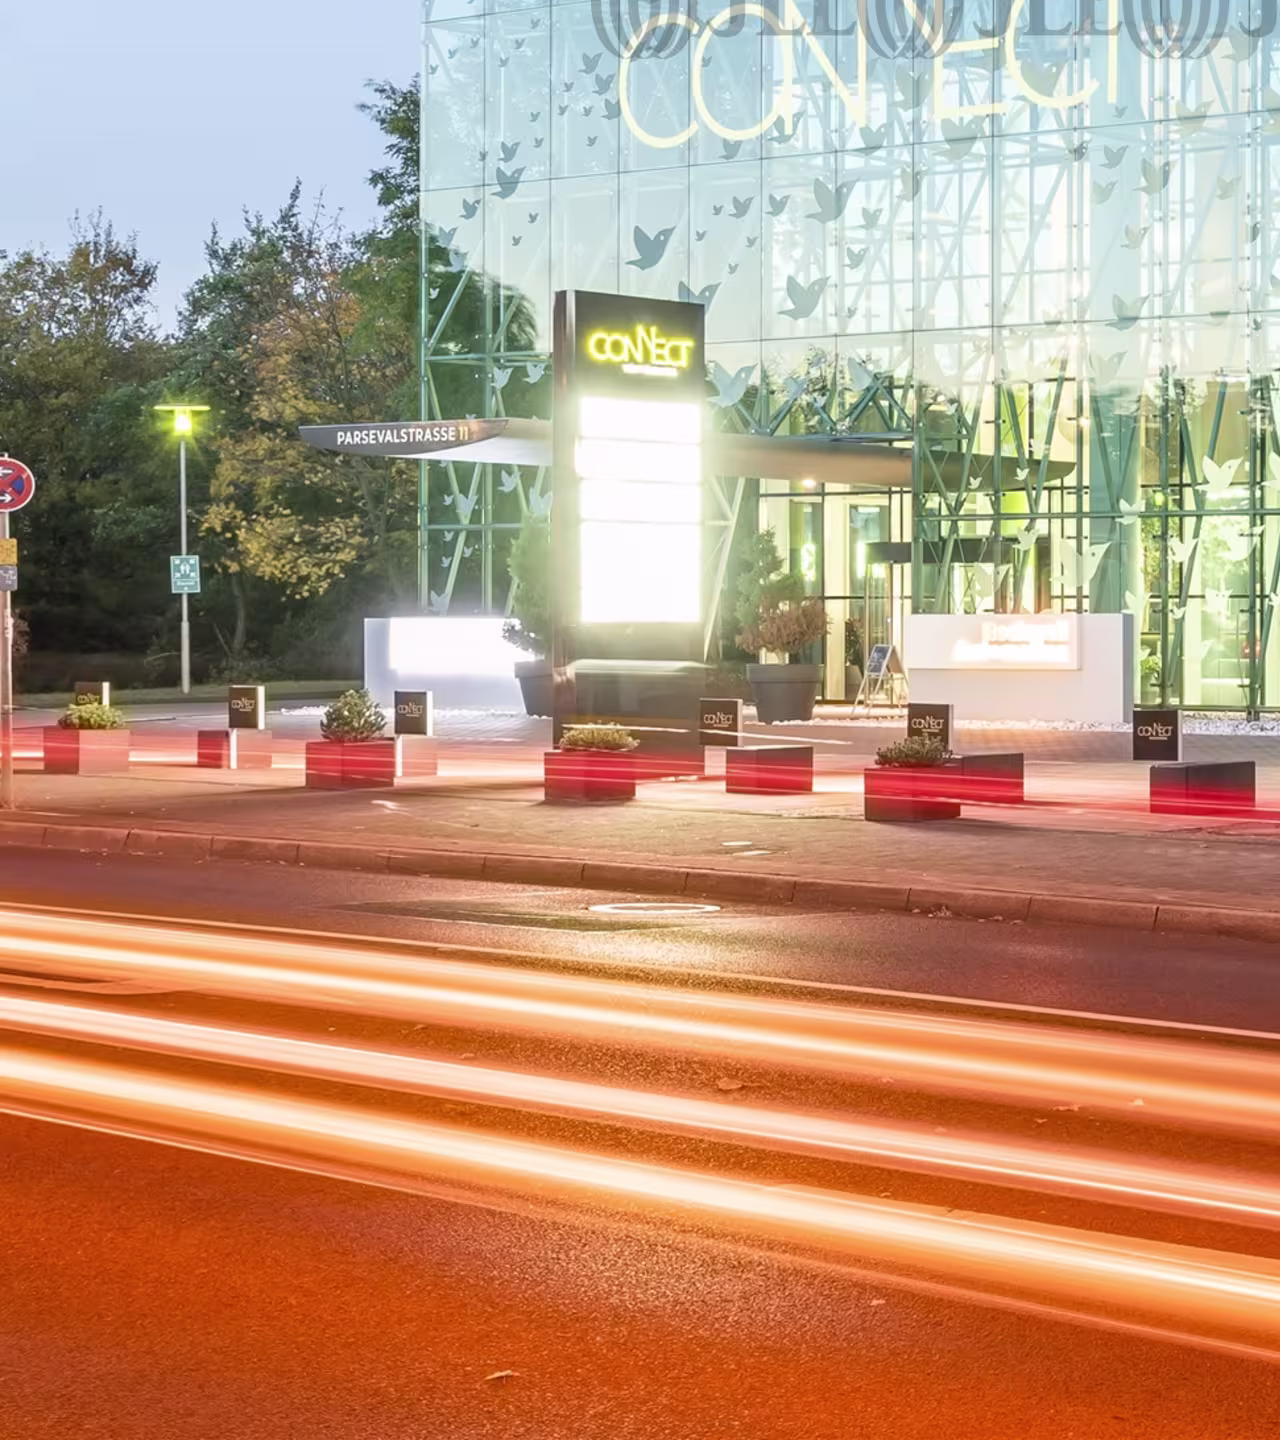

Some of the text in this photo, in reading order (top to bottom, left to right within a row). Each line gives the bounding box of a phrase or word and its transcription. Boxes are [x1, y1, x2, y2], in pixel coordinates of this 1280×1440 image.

[586, 323, 695, 369] CONNECT
[336, 426, 469, 446] PARSEVALSTRASSE 11
